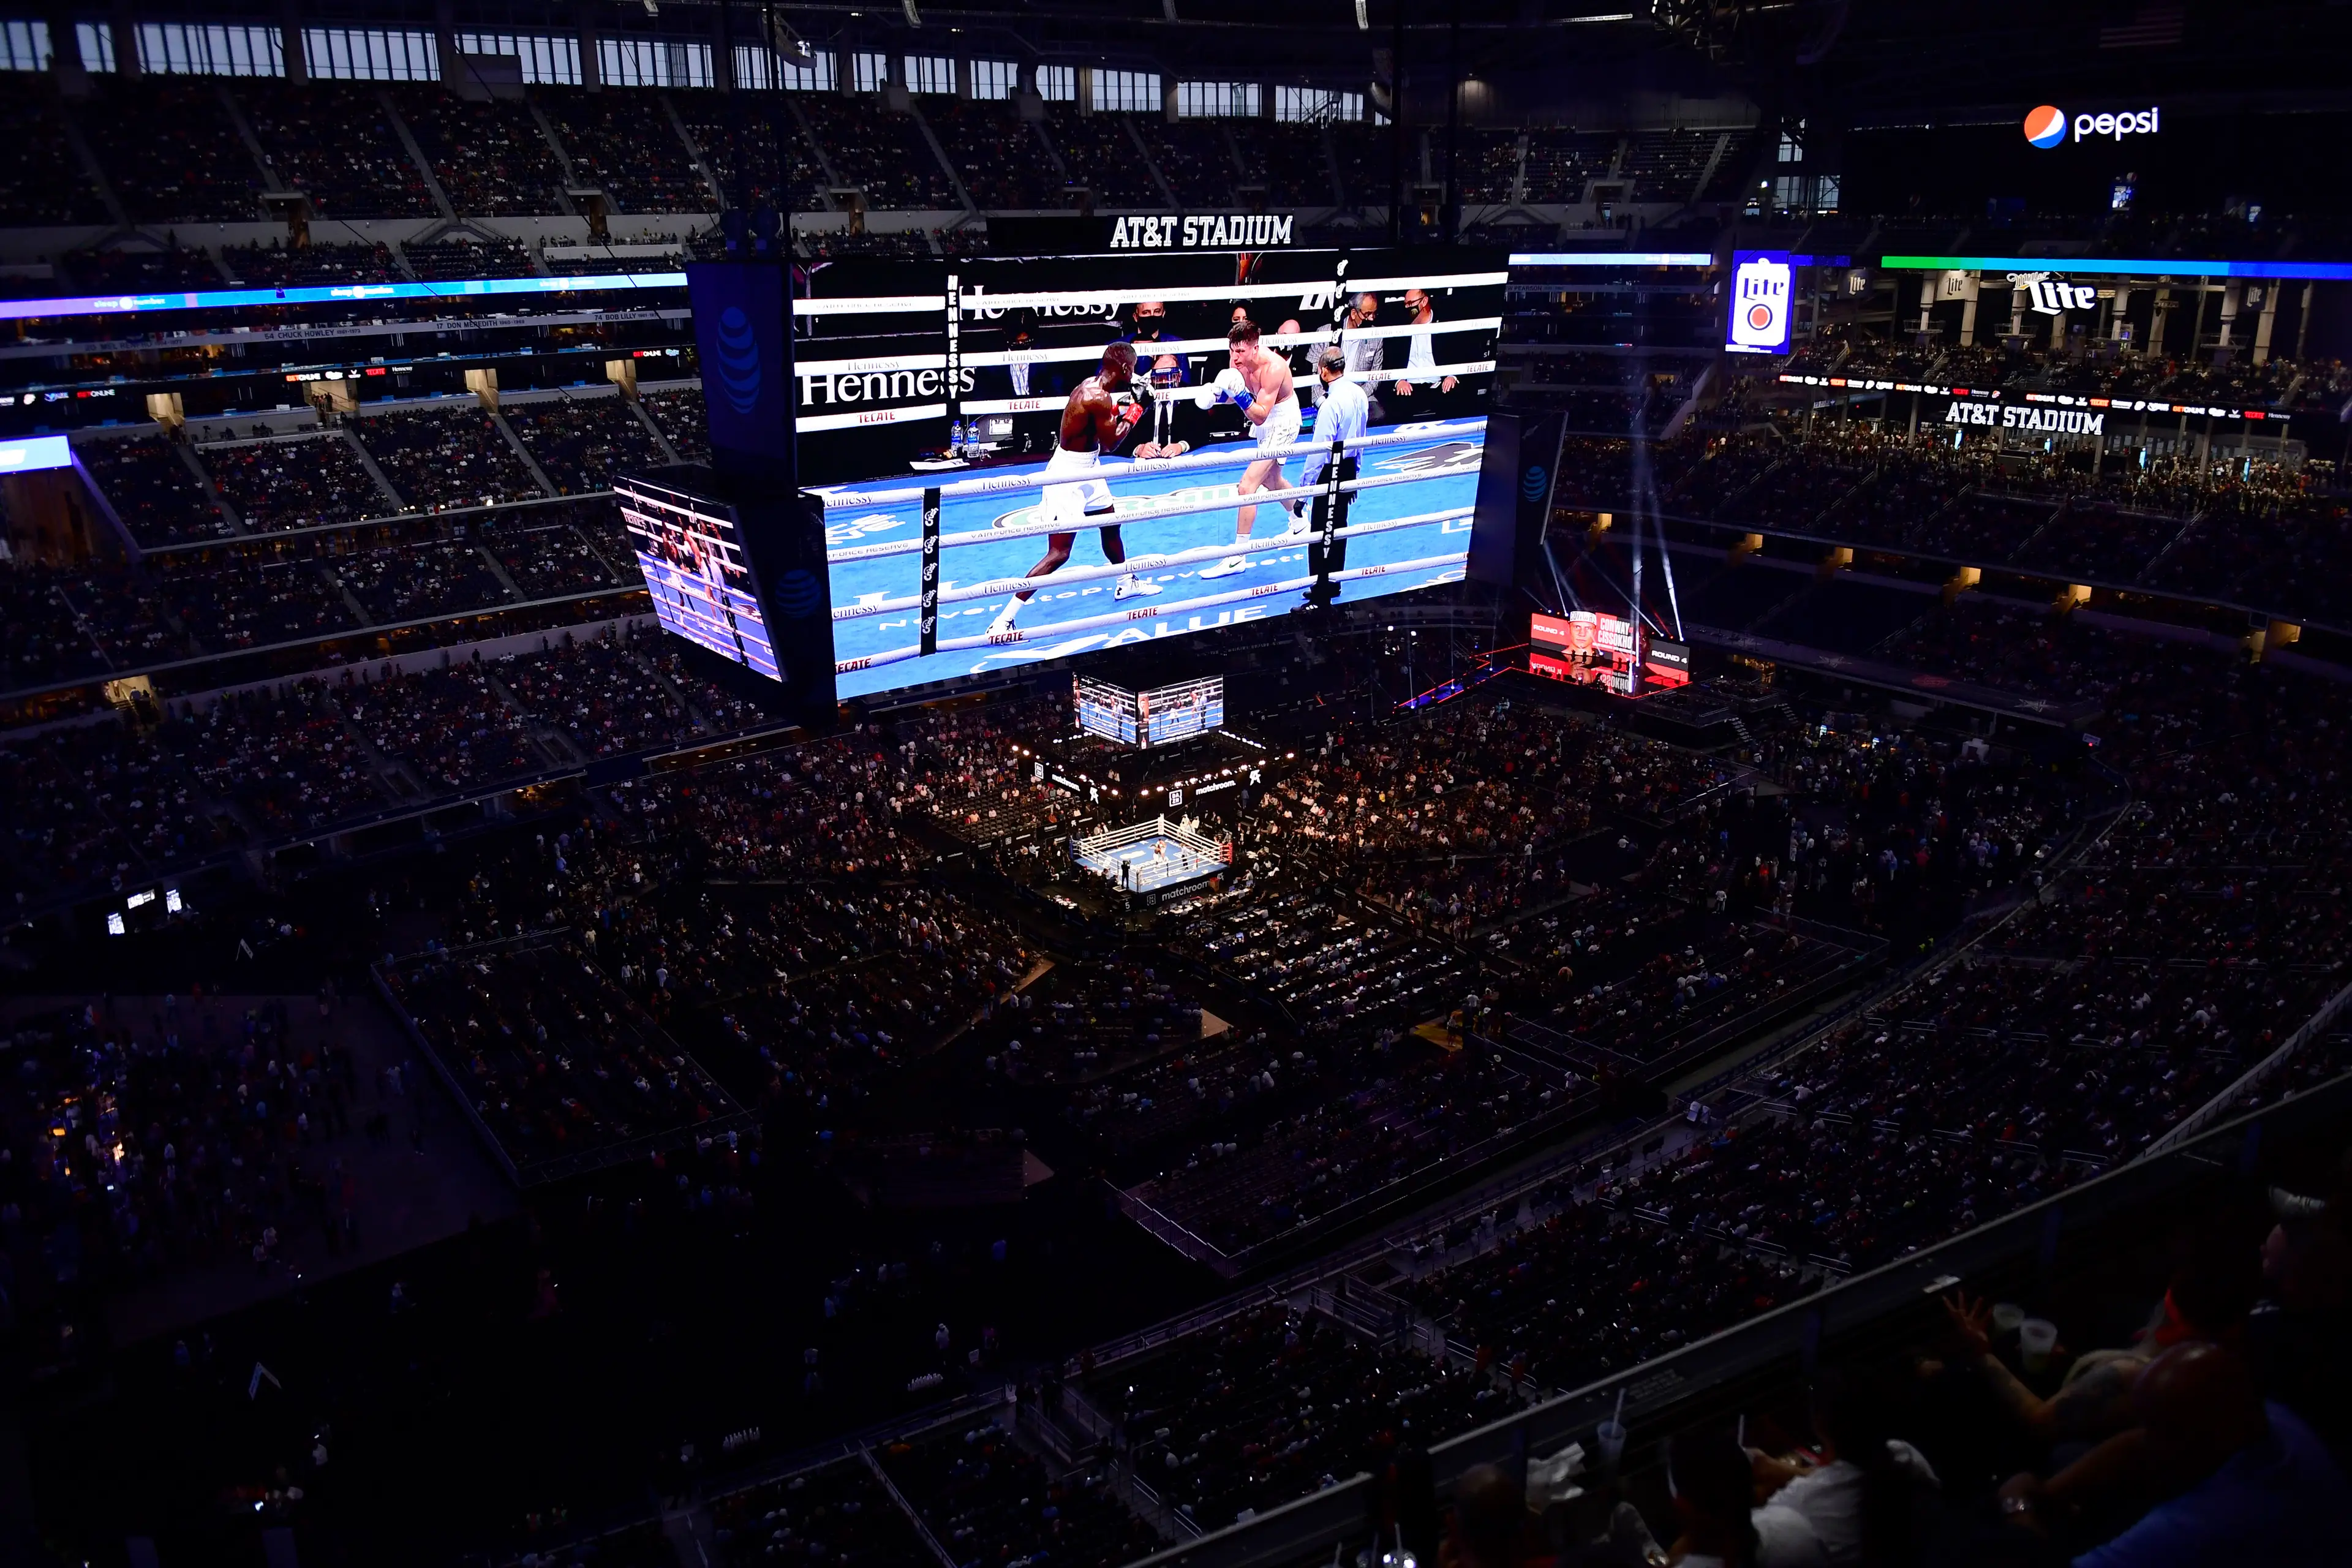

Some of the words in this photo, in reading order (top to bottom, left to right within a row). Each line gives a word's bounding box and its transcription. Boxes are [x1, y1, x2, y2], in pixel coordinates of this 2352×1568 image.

[2074, 106, 2159, 143] pepsi
[1110, 216, 1178, 247] AT&T
[1183, 215, 1293, 246] STADIUM
[1849, 277, 1866, 295] Lite
[1947, 277, 1962, 295] Lite
[2006, 271, 2051, 290] Miller
[1743, 277, 1784, 300] Lite
[2029, 282, 2096, 315] Lite
[2246, 285, 2262, 307] Lite
[948, 275, 958, 399] HENNESSY
[1139, 345, 1180, 353] Hennessy
[1003, 353, 1049, 362] Hennessy
[848, 361, 899, 371] Hennessy
[1466, 364, 1489, 372] TECATE
[1008, 401, 1041, 410] TECATE
[858, 412, 895, 424] TECATE
[1945, 402, 1999, 426] AT&T
[2002, 406, 2104, 435] STADIUM
[1371, 435, 1407, 446] Hennessy
[1256, 448, 1295, 458] Hennessy
[1128, 462, 1171, 473] Hennessy
[982, 477, 1032, 489] Hennessy
[1324, 453, 1341, 559] HENNESSY
[1023, 522, 1060, 531] RESERVE
[1363, 520, 1396, 530] Hennessy
[1251, 538, 1289, 549] Hennessy
[1125, 558, 1167, 571] Hennessy
[984, 581, 1033, 594] Hennessy
[1251, 584, 1278, 596] TECATE
[833, 605, 880, 619] ennessy
[1127, 607, 1158, 620] TECATE
[1533, 624, 1558, 635] ROUND
[1600, 617, 1630, 635] CONWAY
[989, 631, 1025, 644] TECATE
[1597, 630, 1632, 649] CISSOKHO
[1651, 650, 1679, 663] ROUND
[1196, 780, 1237, 796] matchroom.
[1162, 880, 1209, 902] matchroom
[1125, 901, 1130, 910] 5
